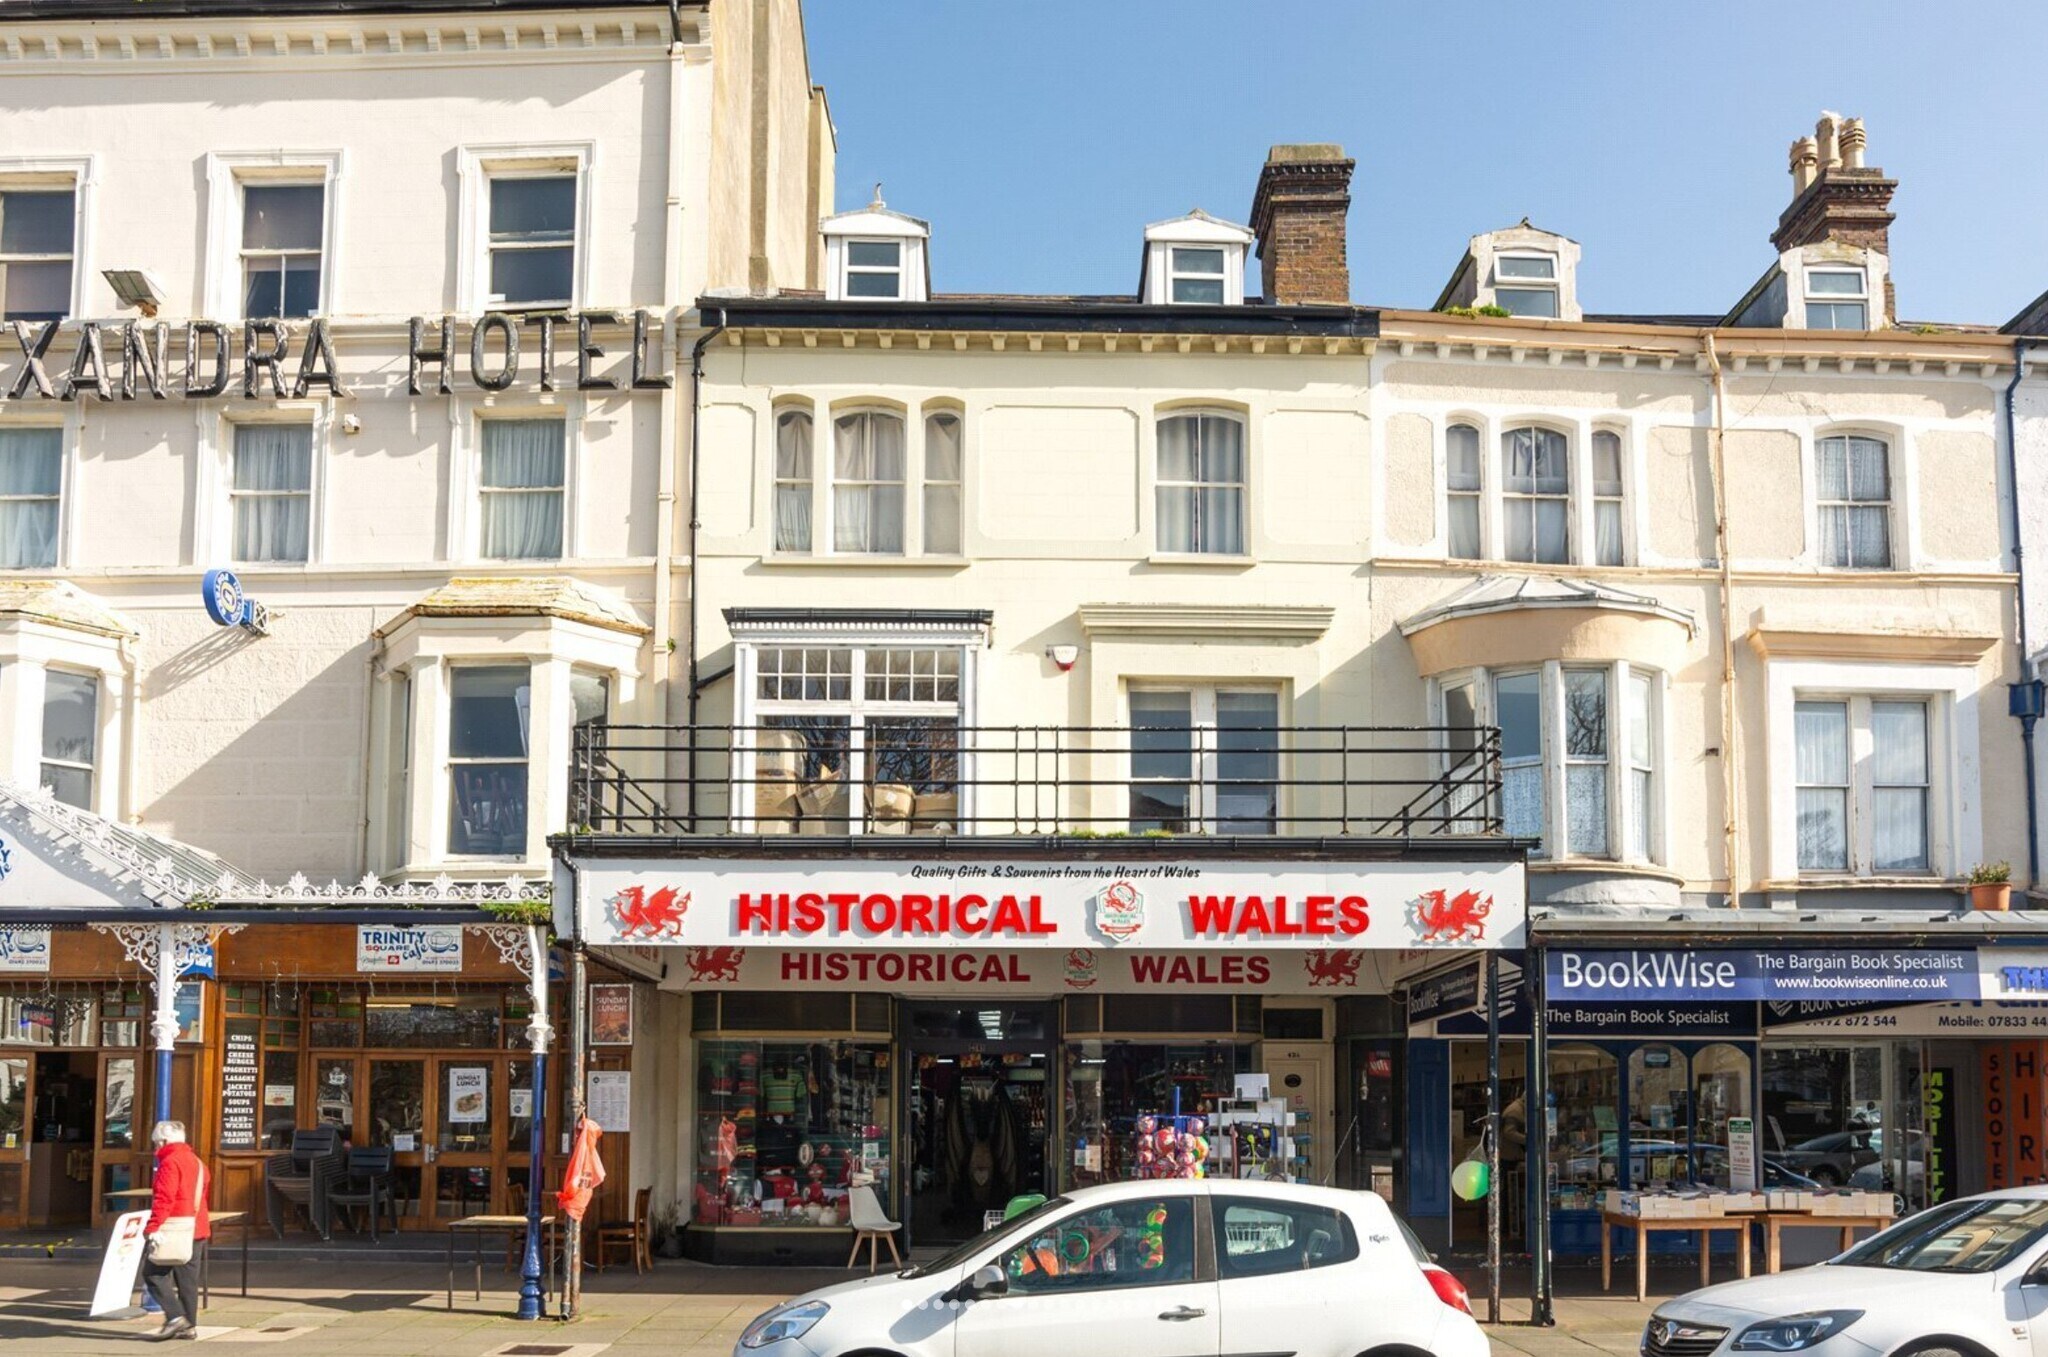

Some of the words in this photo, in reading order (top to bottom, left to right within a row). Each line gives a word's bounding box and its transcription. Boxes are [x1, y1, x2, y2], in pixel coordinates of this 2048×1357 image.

[0, 317, 344, 400] XANDRA
[409, 308, 672, 396] HOTEL
[911, 865, 955, 879] Quality
[957, 865, 987, 878] Gifts
[991, 865, 1002, 877] &
[1004, 865, 1062, 878] Souvenirs
[1064, 866, 1091, 878] from
[1094, 866, 1112, 878] the
[1114, 865, 1148, 878] Heart
[1150, 866, 1163, 878] of
[1164, 866, 1201, 878] Wales
[737, 893, 1058, 934] HISTORICAL
[1188, 895, 1371, 935] WALES
[362, 931, 426, 944] TRINITY
[781, 952, 1031, 983] HISTORICAL
[1130, 954, 1271, 984] WALES
[1562, 951, 1736, 988] BookWise
[1756, 954, 1784, 969] The
[1789, 954, 1846, 972] Bargain
[1851, 954, 1889, 970] Book
[1893, 954, 1964, 972] Specialist
[1775, 976, 1948, 989] www.bookwiseonline.co.uk
[1547, 1009, 1571, 1023] The
[1576, 1009, 1626, 1025] Bargain
[1631, 1009, 1664, 1023] Book
[1668, 1010, 1729, 1026] Specialist
[1873, 1015, 1897, 1026] 544
[1938, 1016, 1984, 1027] Mobile:
[1988, 1016, 2027, 1027] 07833
[1988, 1054, 2003, 1191] SCOOTE
